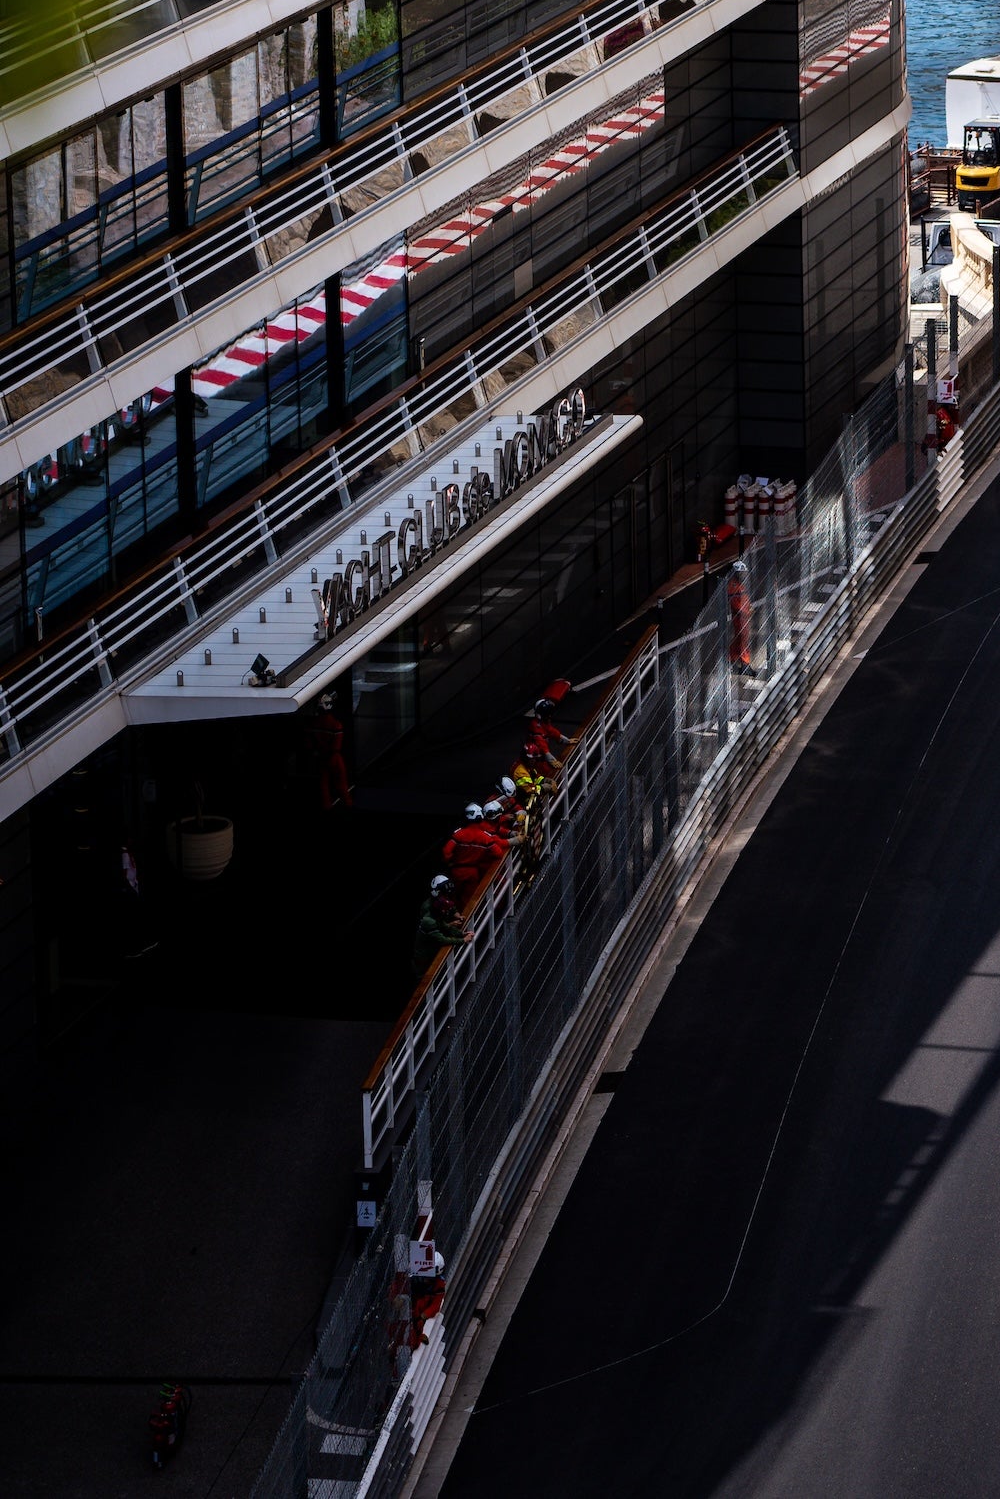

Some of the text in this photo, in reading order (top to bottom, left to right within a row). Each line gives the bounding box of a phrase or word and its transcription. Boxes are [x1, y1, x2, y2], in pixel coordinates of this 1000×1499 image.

[311, 530, 396, 641] YACHT
[398, 483, 461, 578] CLUB
[493, 387, 586, 502] MONACO
